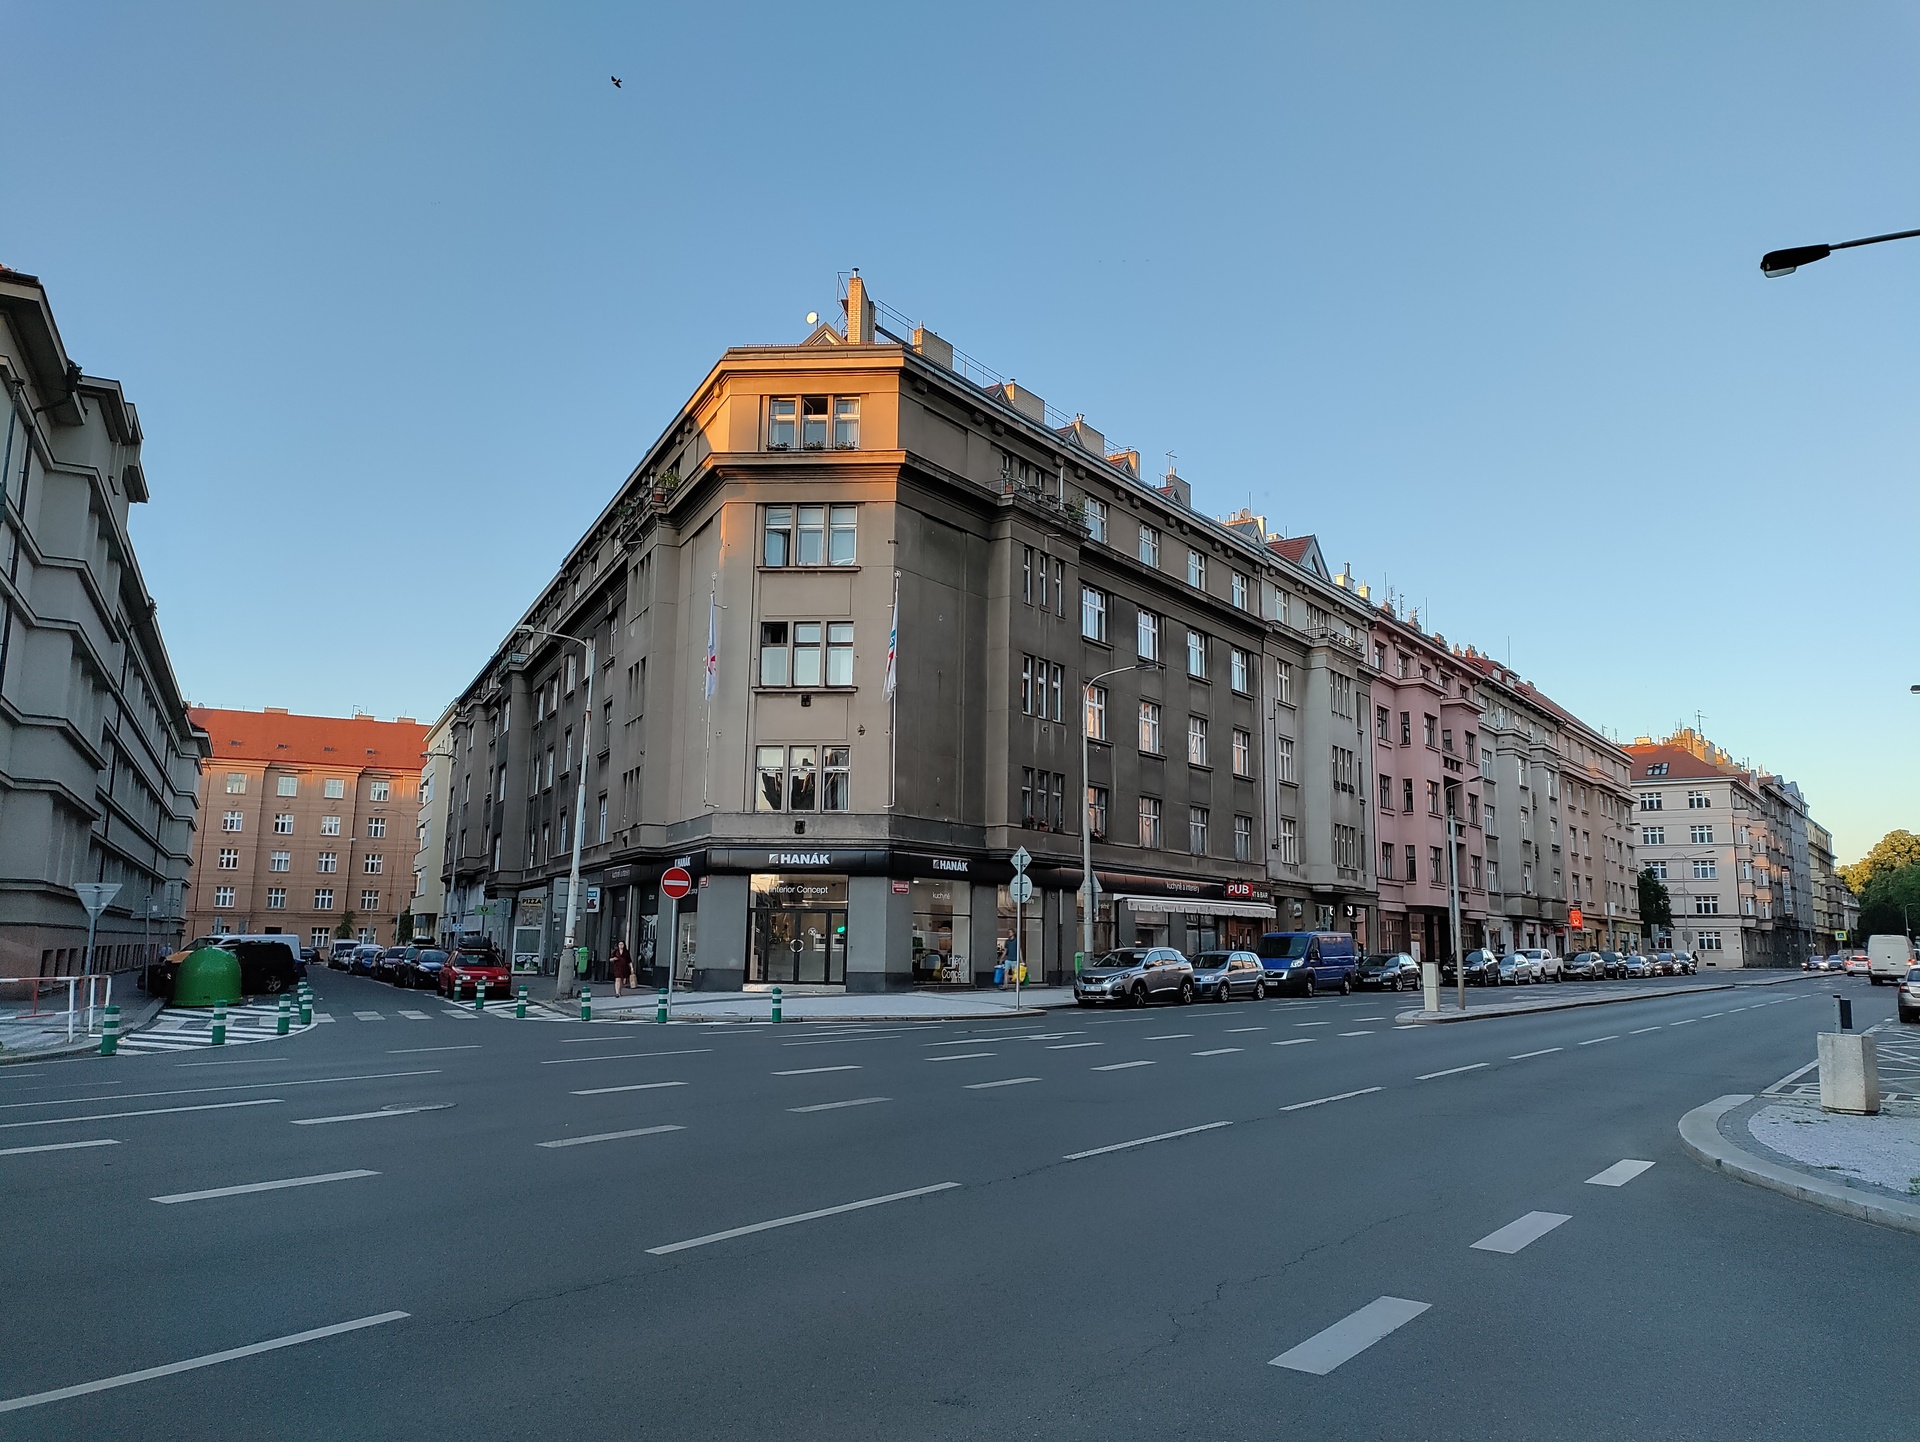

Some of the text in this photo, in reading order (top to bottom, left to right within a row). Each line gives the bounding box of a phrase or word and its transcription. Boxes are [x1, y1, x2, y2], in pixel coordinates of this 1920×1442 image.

[781, 852, 830, 865] HANÁK
[940, 859, 968, 872] HANÁK
[796, 885, 829, 895] Concept
[1227, 883, 1250, 895] PUB
